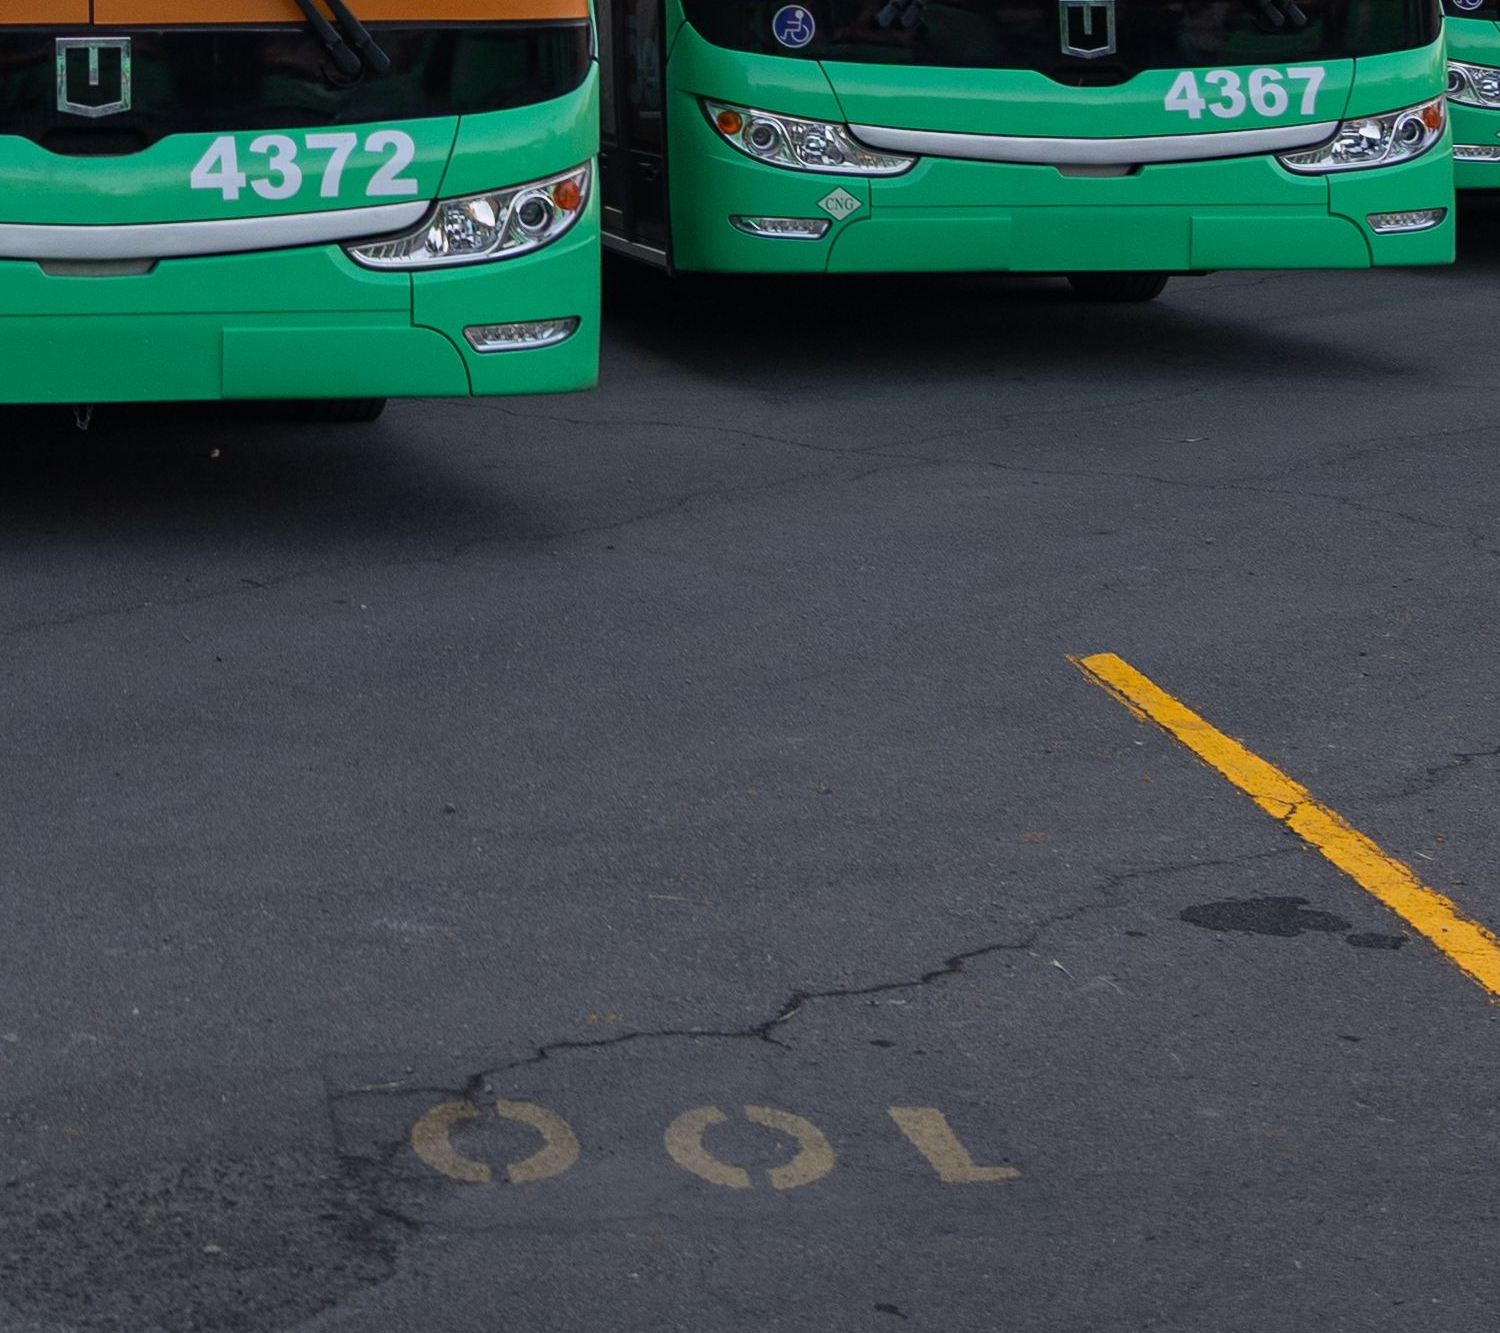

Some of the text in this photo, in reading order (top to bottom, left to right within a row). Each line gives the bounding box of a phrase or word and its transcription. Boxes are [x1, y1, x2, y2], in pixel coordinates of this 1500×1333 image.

[1163, 67, 1327, 120] 4367
[189, 129, 419, 202] 4372
[824, 196, 856, 212] CNG
